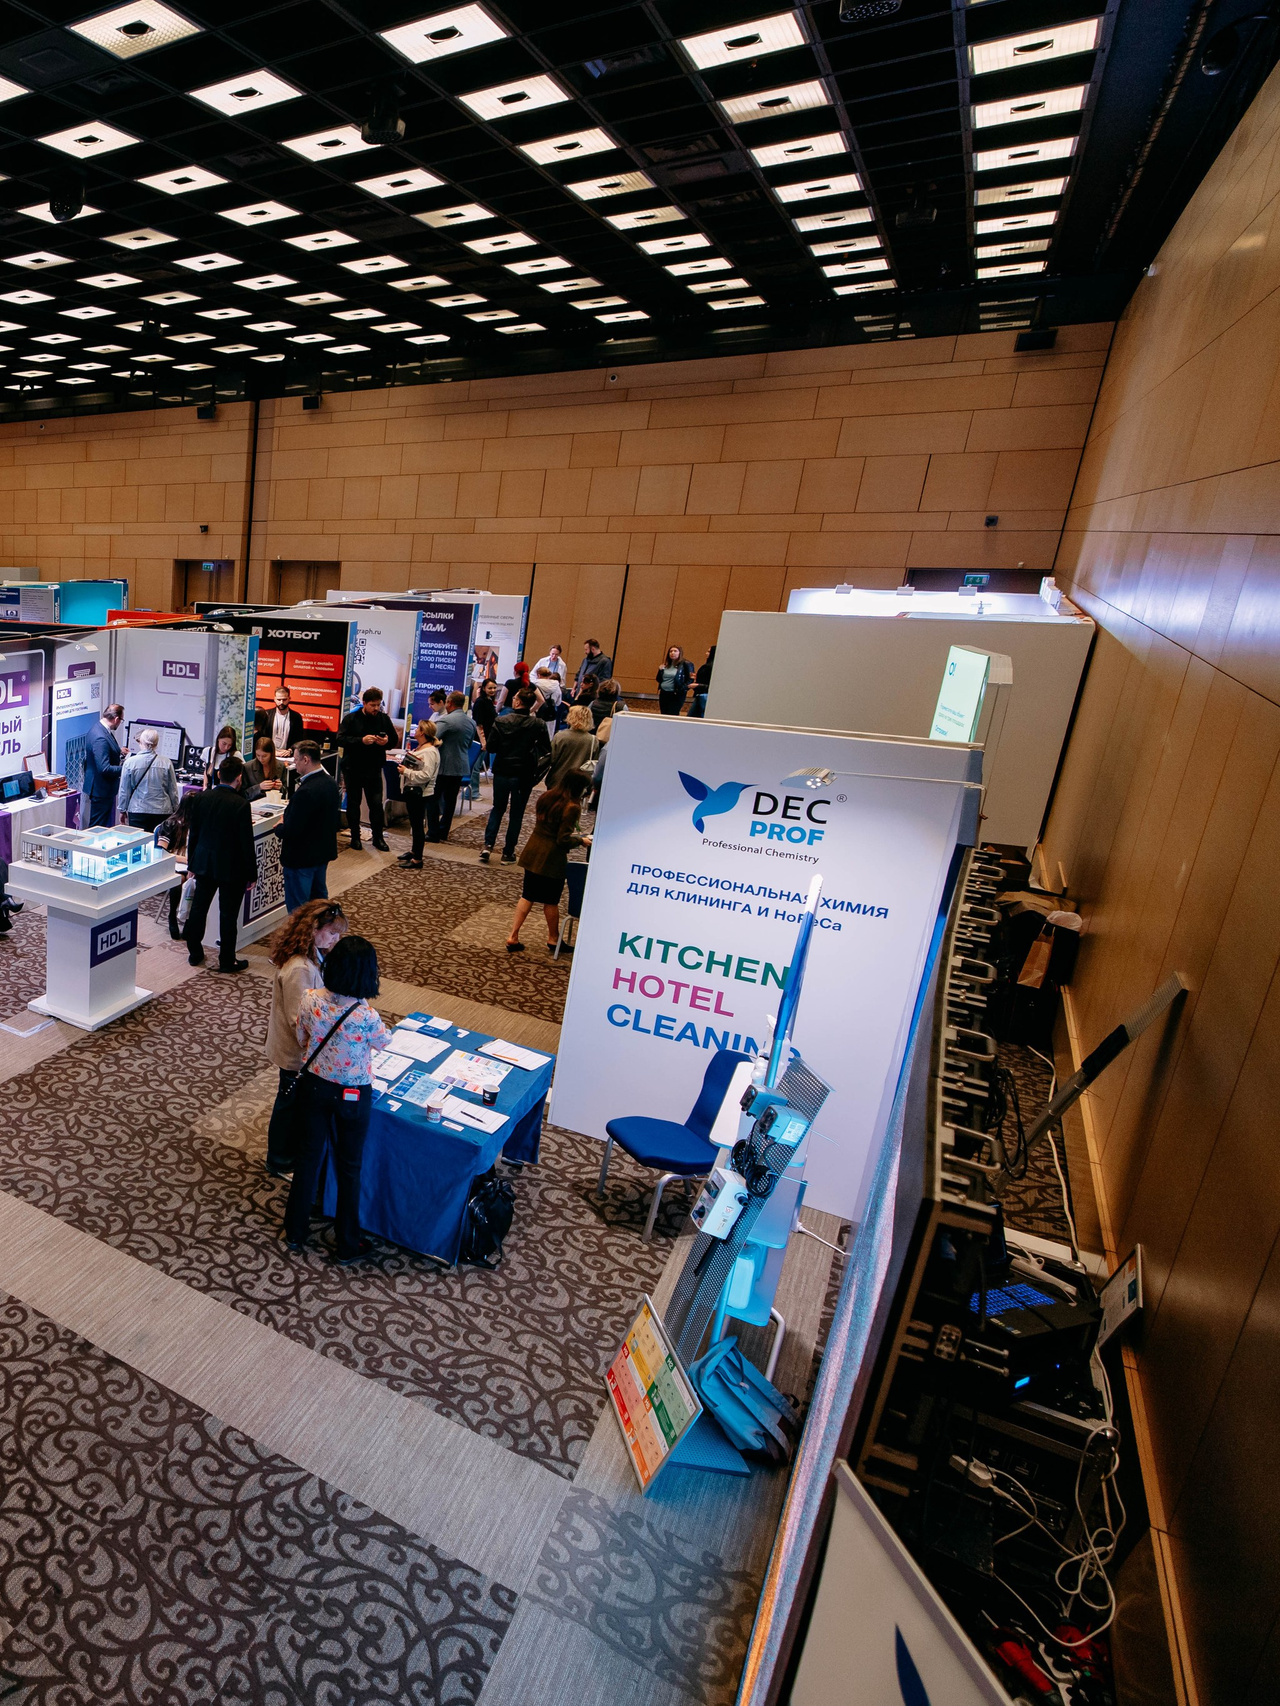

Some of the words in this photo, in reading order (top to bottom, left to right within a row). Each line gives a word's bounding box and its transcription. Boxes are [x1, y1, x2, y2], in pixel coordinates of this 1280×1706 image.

[268, 629, 321, 641] ХОТБОТ
[420, 649, 457, 657] БЕСПЛАТНО
[166, 662, 196, 677] HDL
[58, 690, 70, 699] HDL
[752, 792, 831, 825] DEC
[749, 821, 825, 847] PROF
[702, 838, 763, 856] Professional
[765, 849, 820, 865] Chemistry
[627, 882, 660, 898] ДЛЯ
[665, 888, 752, 915] КЛИНИНГА
[757, 906, 770, 918] И
[820, 897, 889, 919] ХИМИЯ
[100, 930, 127, 951] HDL
[619, 932, 790, 990] KITCHEN
[612, 968, 735, 1018] HOTEL
